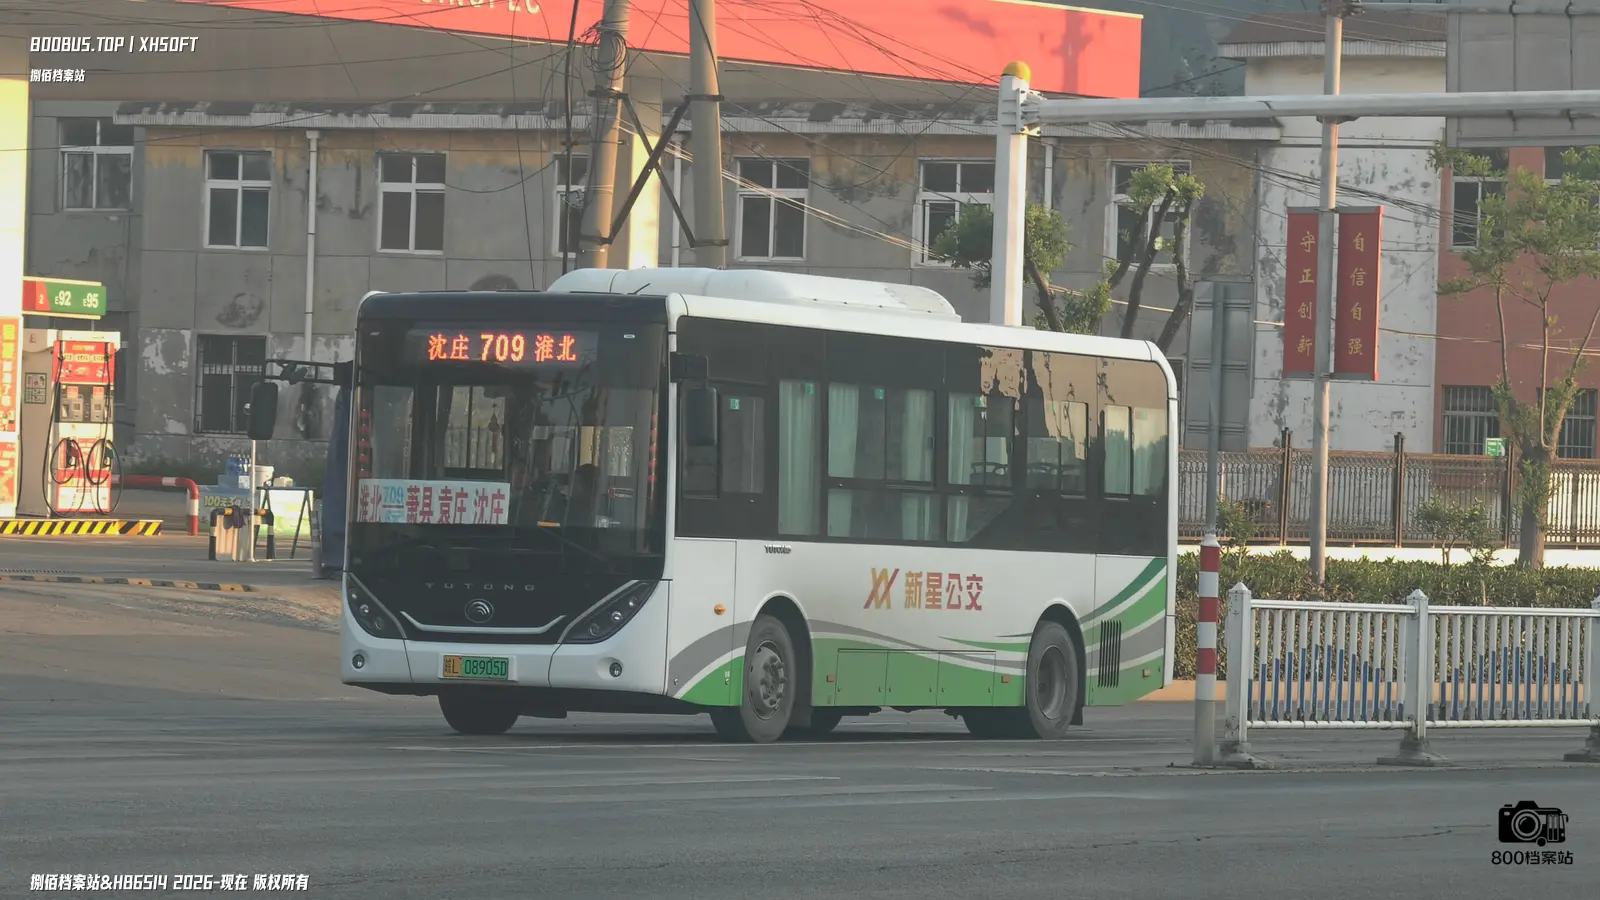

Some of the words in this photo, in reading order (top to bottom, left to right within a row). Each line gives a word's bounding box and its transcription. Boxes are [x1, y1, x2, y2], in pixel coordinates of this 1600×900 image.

[54, 290, 72, 306] E92
[82, 293, 99, 308] E95
[1297, 231, 1316, 357] 守正创新
[1347, 232, 1367, 356] 自信自强
[428, 334, 469, 361] 沈庄
[480, 334, 525, 362] 709
[534, 334, 577, 362] 淮北
[383, 486, 404, 504] 709
[425, 582, 535, 591] YUTONG
[904, 570, 983, 611] 新星公交
